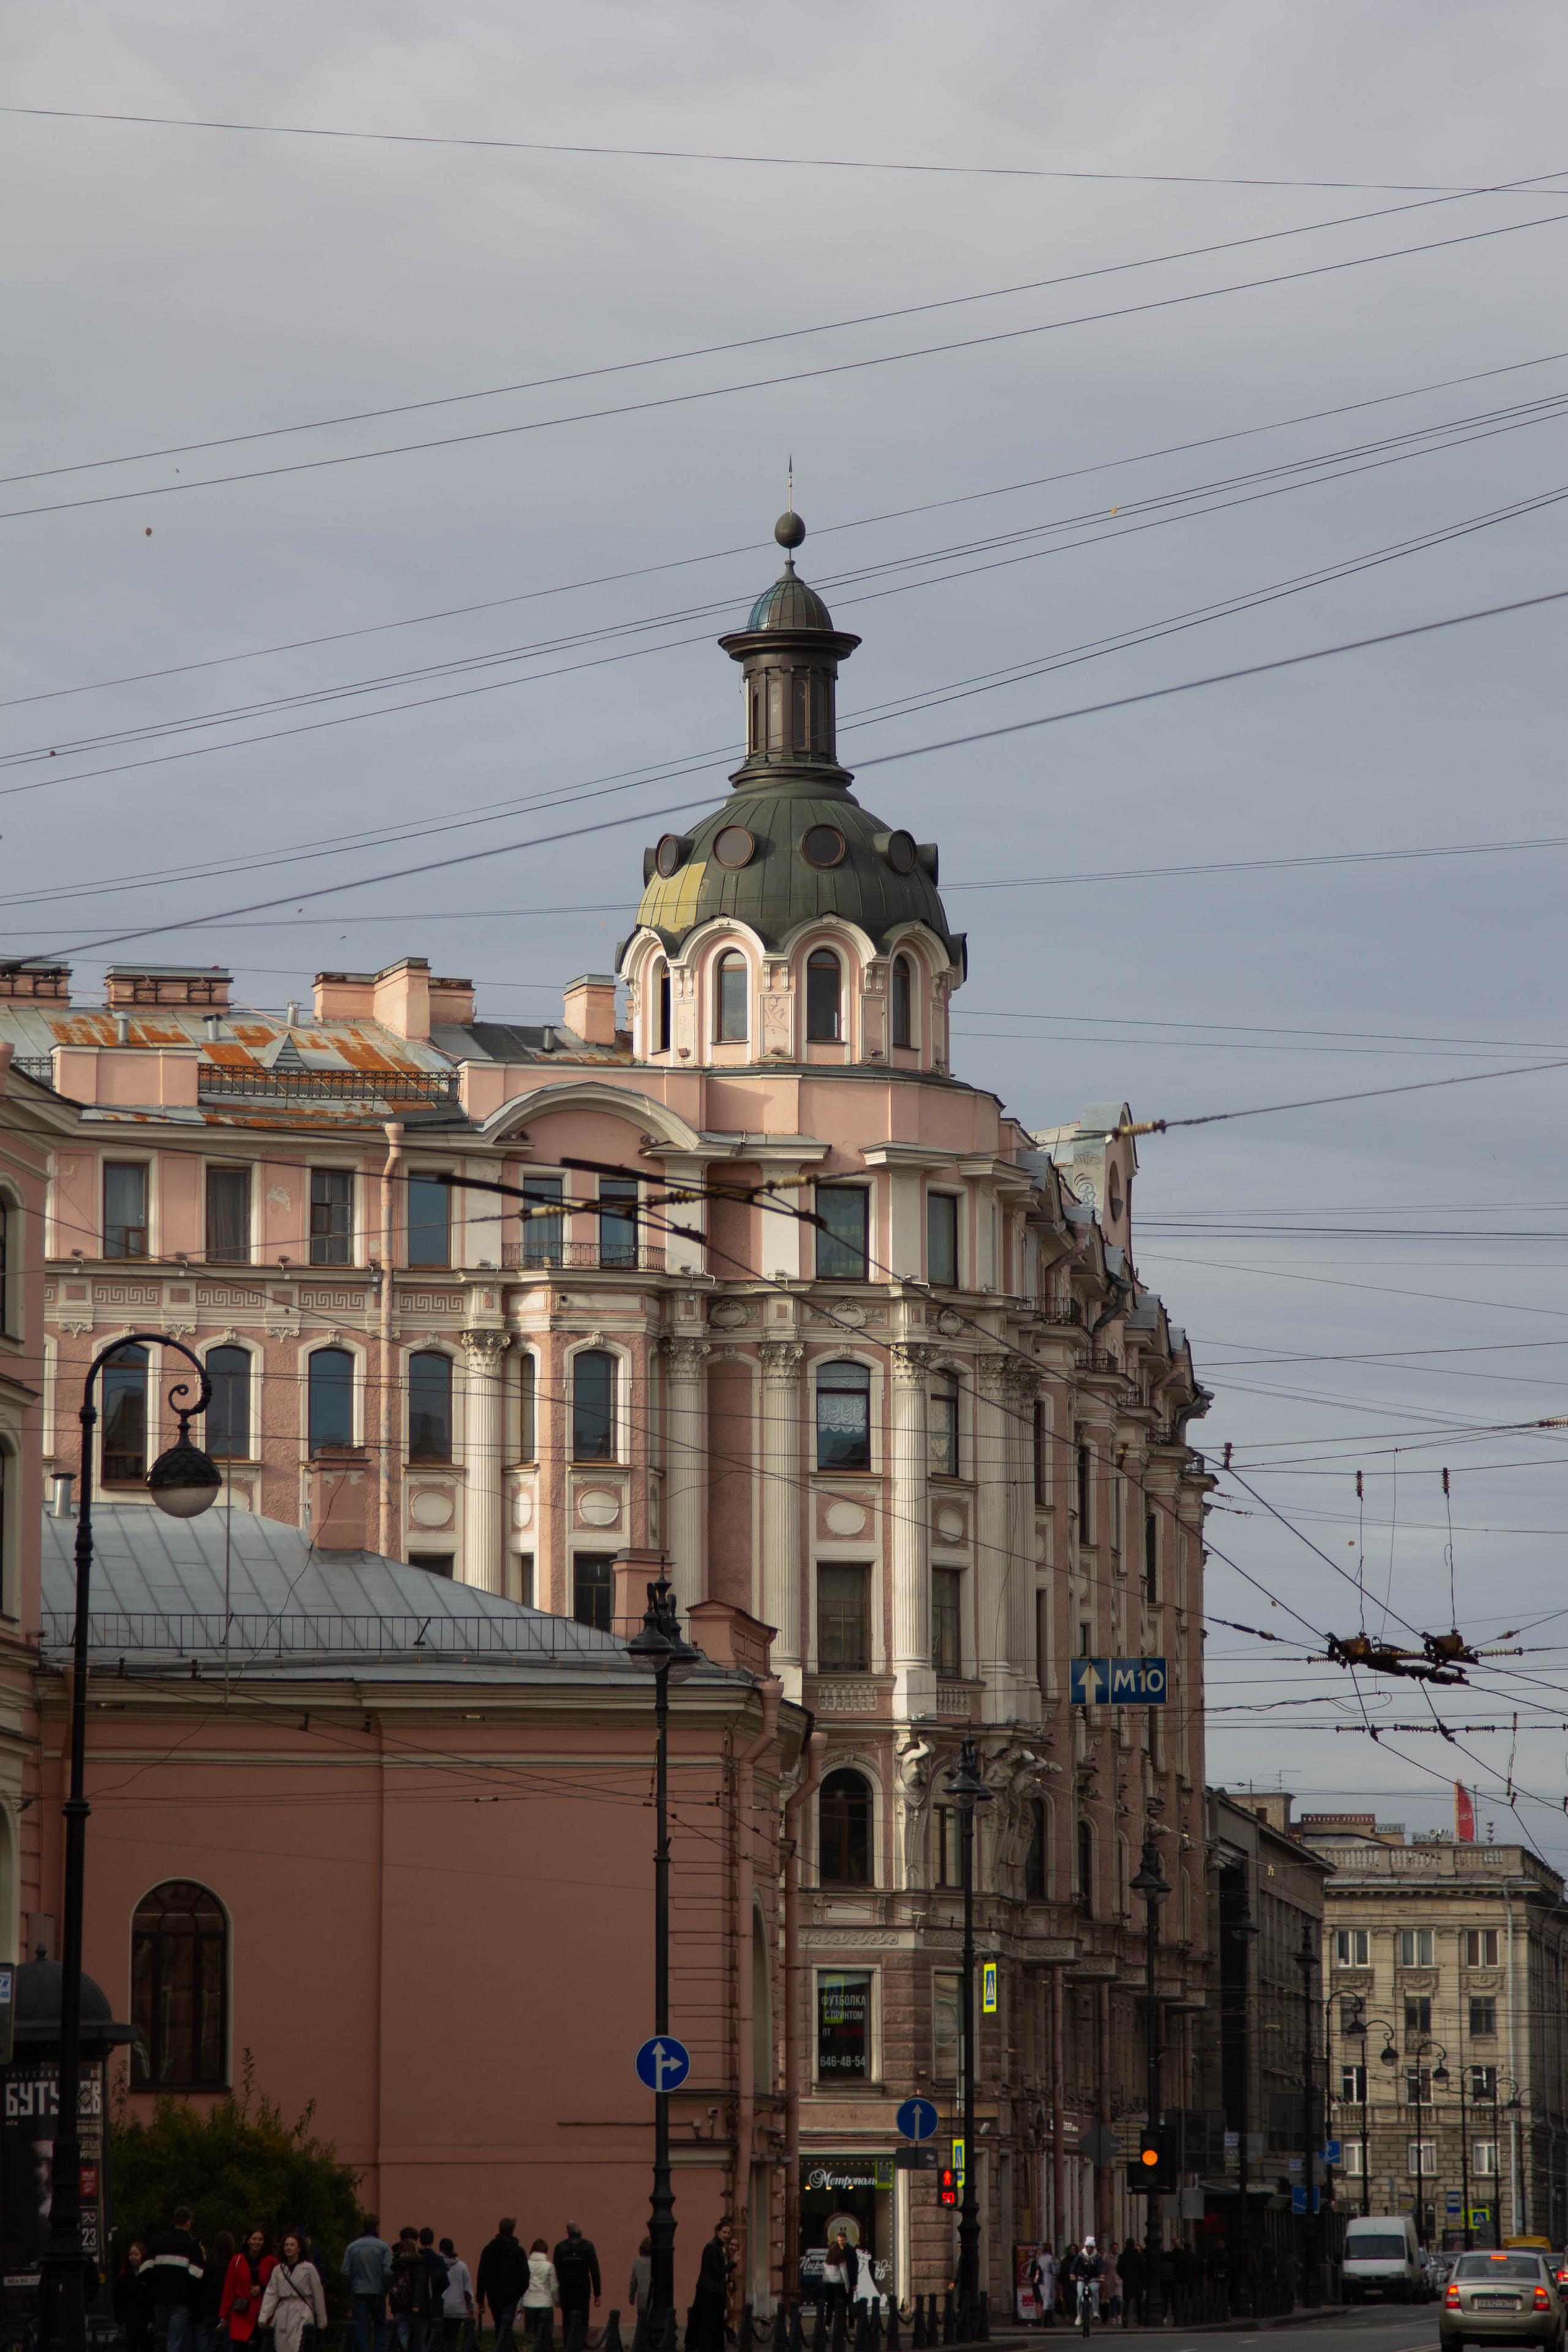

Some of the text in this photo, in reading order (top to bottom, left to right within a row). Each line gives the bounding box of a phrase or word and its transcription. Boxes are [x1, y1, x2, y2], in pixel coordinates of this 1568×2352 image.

[1114, 1669, 1164, 1692] M10
[821, 1995, 866, 2007] ФУТБОЛКА
[831, 2010, 864, 2021] ПРИНТОМ
[823, 2028, 831, 2037] ОТ
[820, 2056, 865, 2068] 646-48-54
[809, 2169, 877, 2189] Метрополь
[82, 2228, 97, 2247] 23
